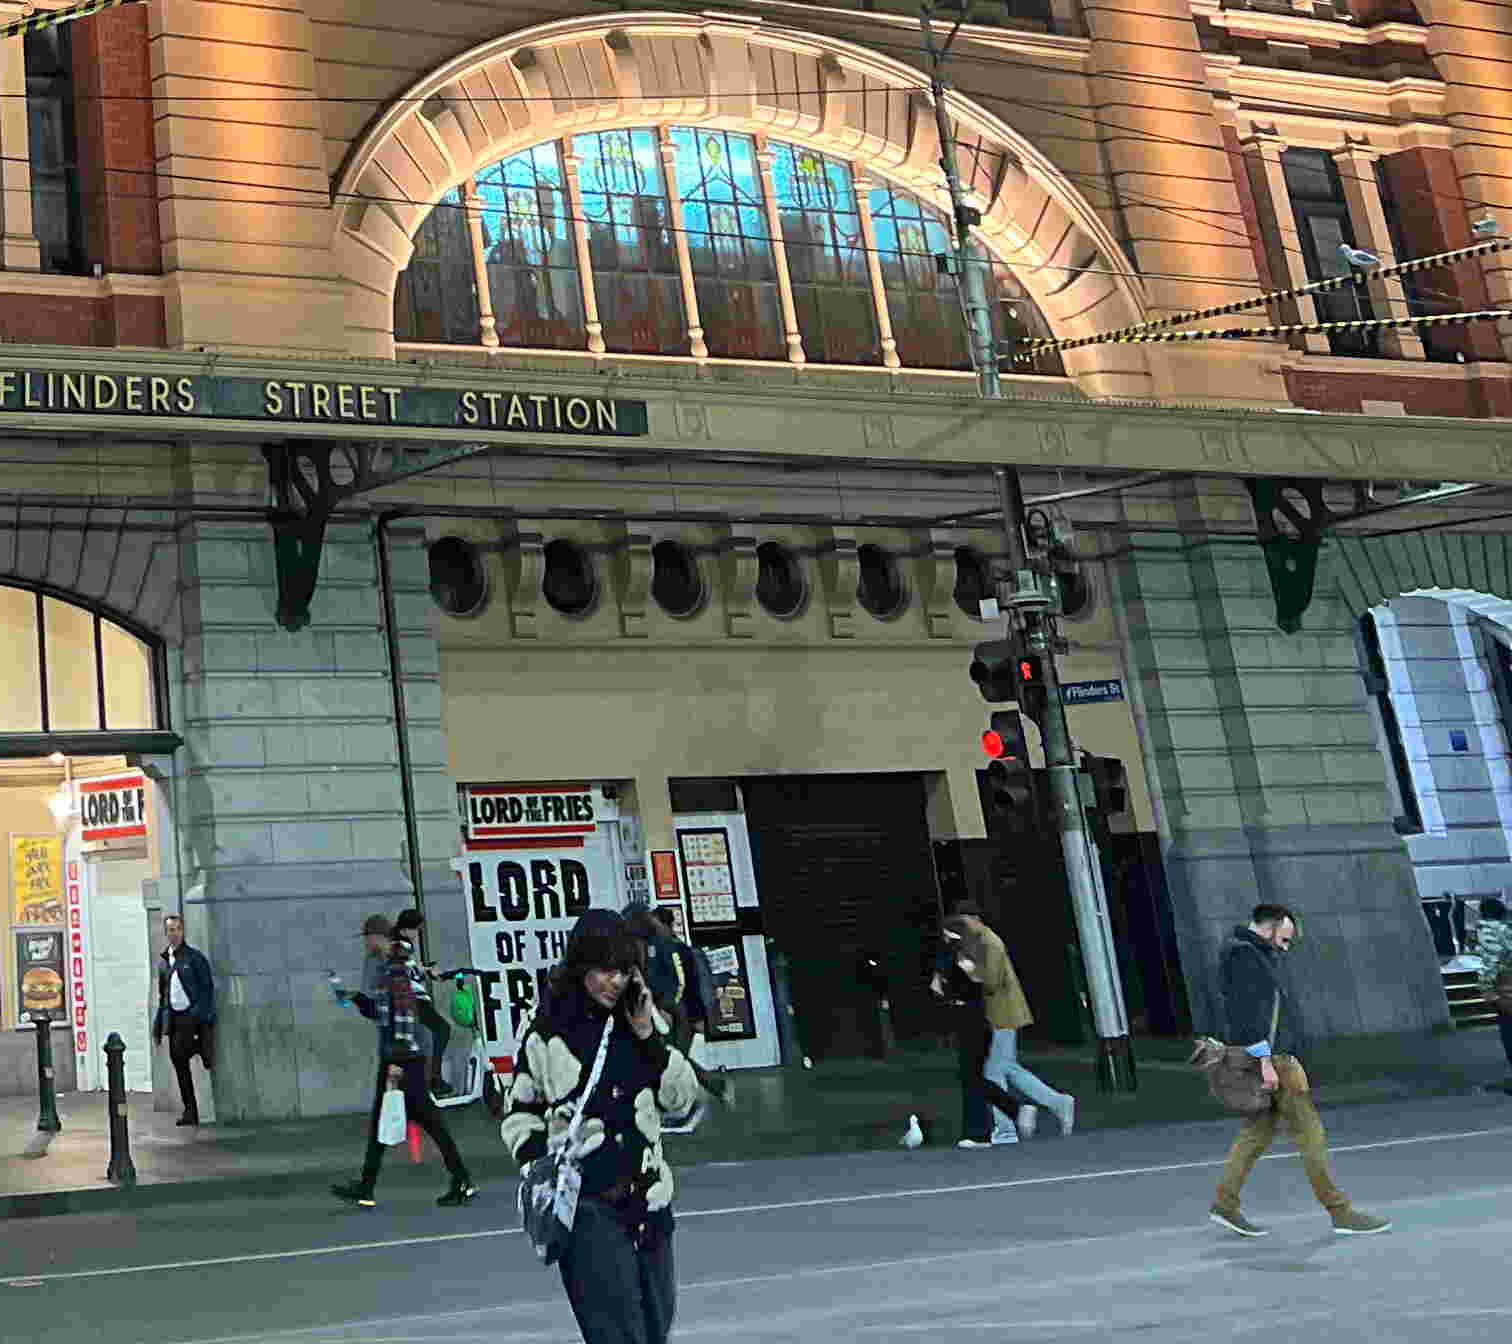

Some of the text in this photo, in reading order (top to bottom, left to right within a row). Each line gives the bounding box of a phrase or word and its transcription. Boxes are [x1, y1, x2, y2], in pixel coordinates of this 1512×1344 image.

[265, 381, 402, 421] STREET
[461, 391, 617, 430] STATION
[81, 792, 119, 826] LORD
[470, 796, 523, 824] LORD
[525, 808, 543, 822] THE
[542, 794, 594, 822] FRIES
[468, 859, 591, 922] LORD
[496, 929, 571, 964] OF TH
